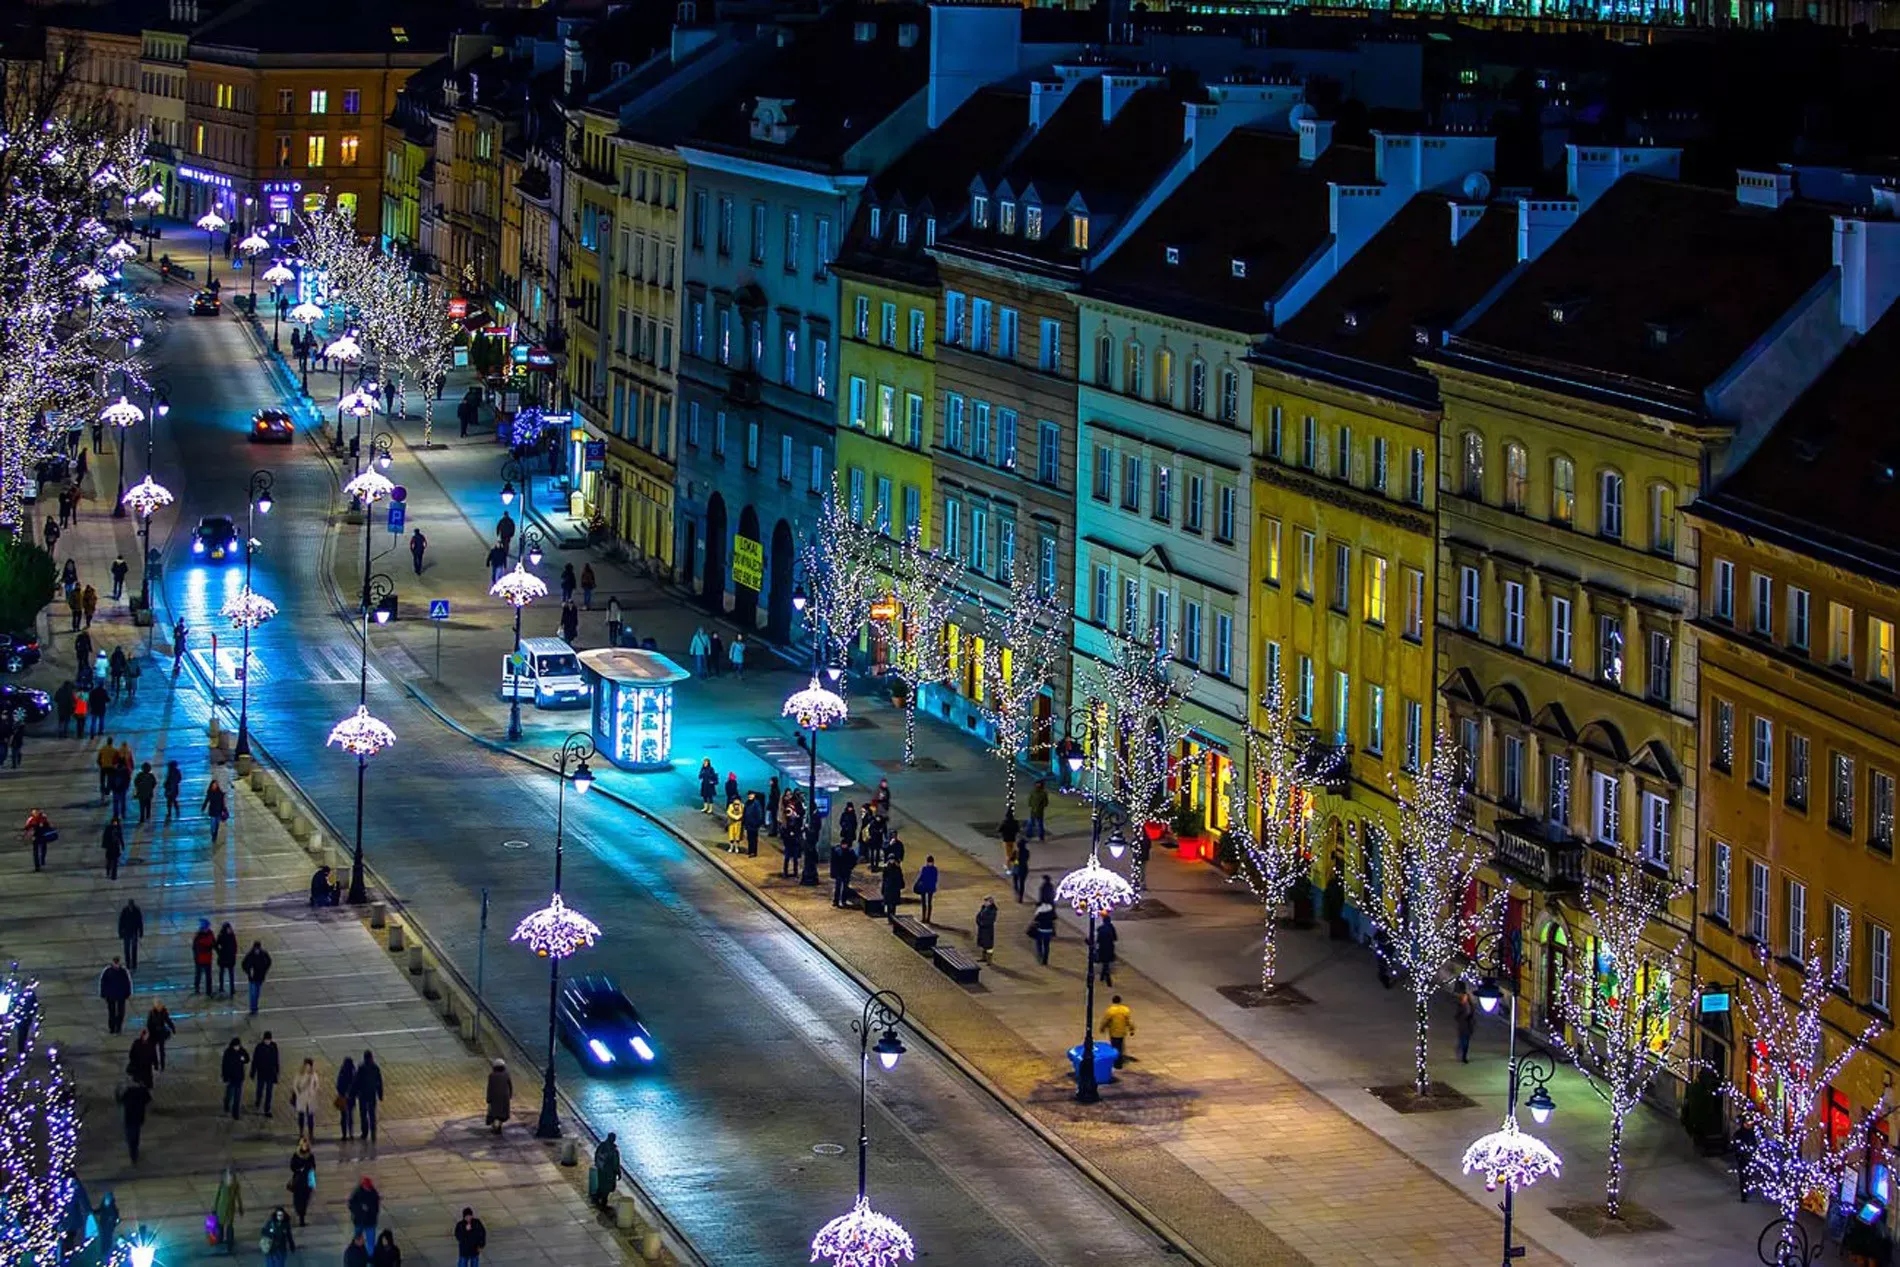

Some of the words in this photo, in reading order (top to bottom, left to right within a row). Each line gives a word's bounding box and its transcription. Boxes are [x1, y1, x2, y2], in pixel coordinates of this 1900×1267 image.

[263, 182, 302, 192] KINO
[392, 510, 402, 523] P
[739, 538, 758, 557] LOKAL
